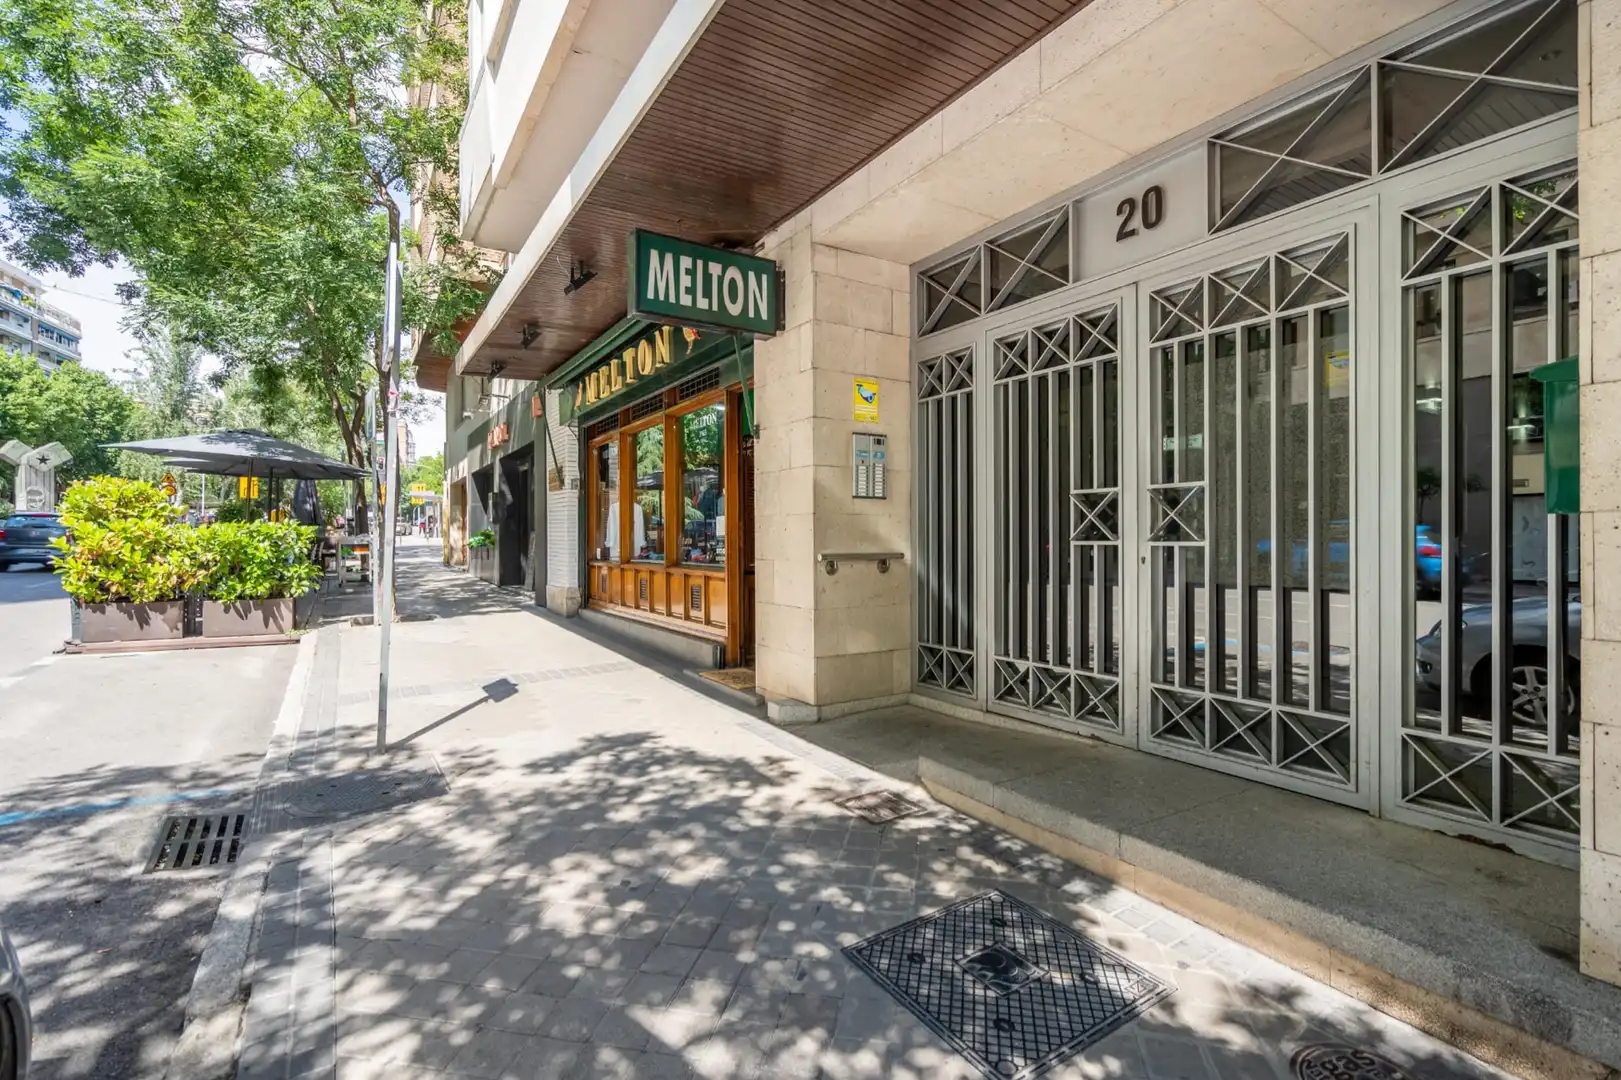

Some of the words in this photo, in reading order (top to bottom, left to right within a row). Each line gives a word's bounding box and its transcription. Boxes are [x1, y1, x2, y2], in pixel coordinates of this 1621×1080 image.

[1116, 185, 1163, 242] 20
[646, 248, 768, 321] MELTON
[585, 325, 672, 405] MELTON
